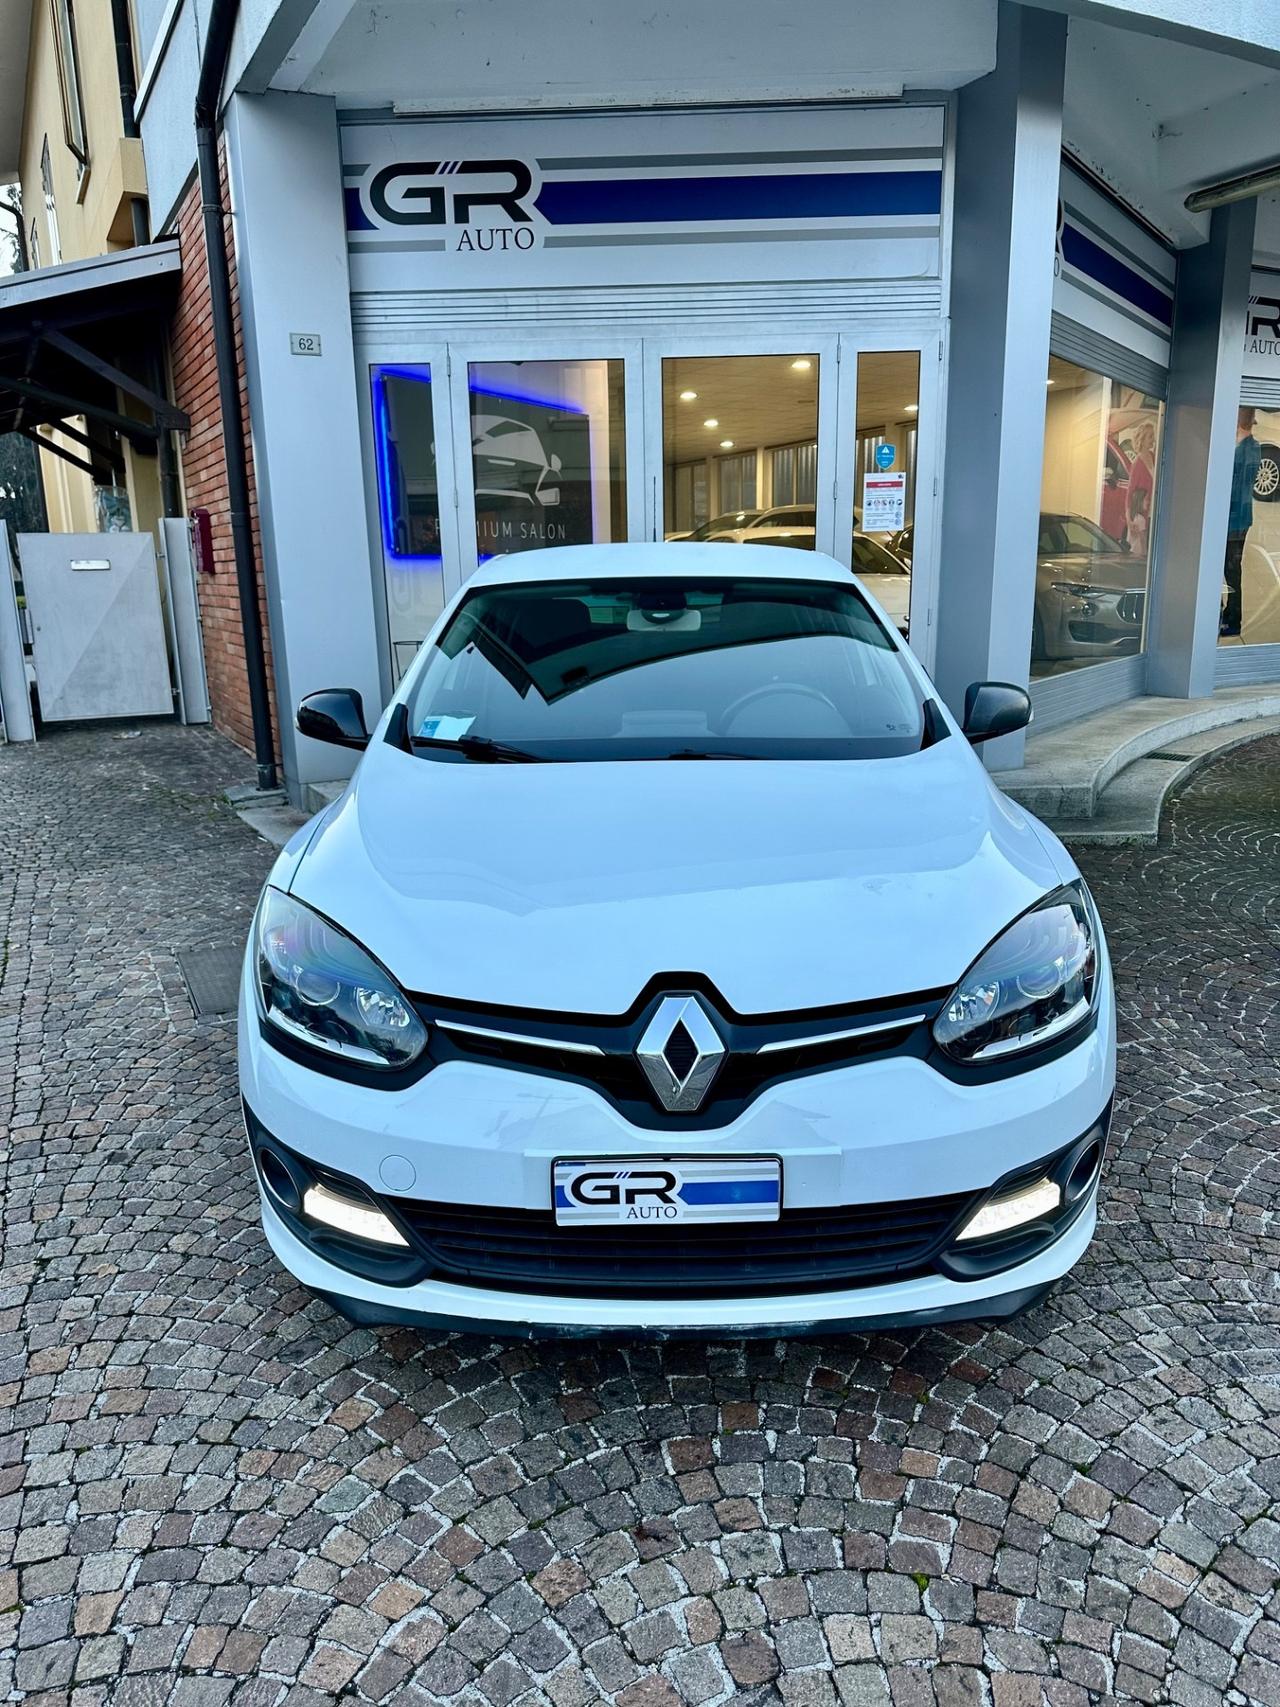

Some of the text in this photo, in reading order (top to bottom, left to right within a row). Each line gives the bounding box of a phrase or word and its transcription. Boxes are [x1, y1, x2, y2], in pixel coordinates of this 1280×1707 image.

[369, 158, 533, 225] GR
[456, 227, 535, 251] AUTO
[299, 337, 314, 351] 62
[520, 522, 566, 540] SALON
[571, 1170, 677, 1205] GR
[626, 1206, 678, 1219] AUTO
